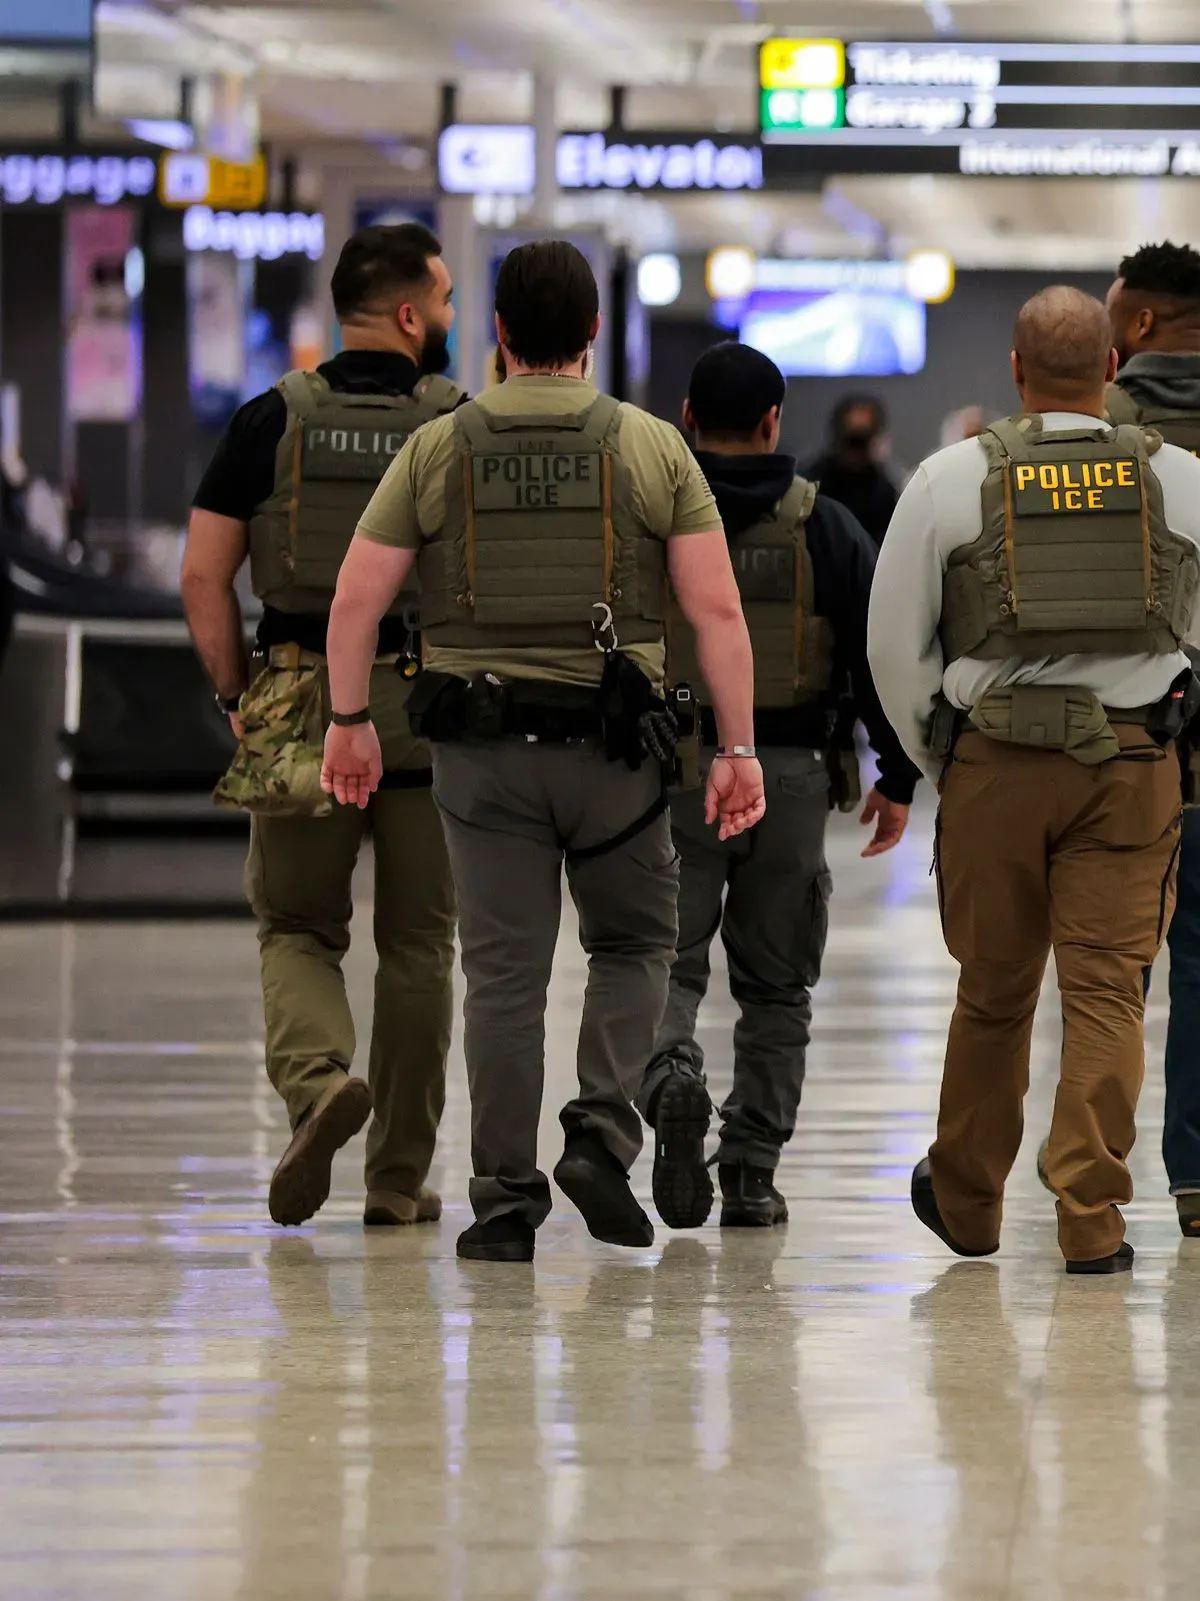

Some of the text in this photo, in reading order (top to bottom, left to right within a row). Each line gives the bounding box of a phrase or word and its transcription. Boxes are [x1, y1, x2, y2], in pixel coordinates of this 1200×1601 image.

[851, 48, 999, 92] Ticketing
[846, 91, 965, 134] Garage
[960, 137, 1169, 175] International
[308, 429, 412, 456] POLIC
[482, 454, 590, 484] POLICE
[1016, 461, 1136, 491] POLICE
[515, 484, 559, 506] ICE
[1051, 489, 1104, 510] ICE
